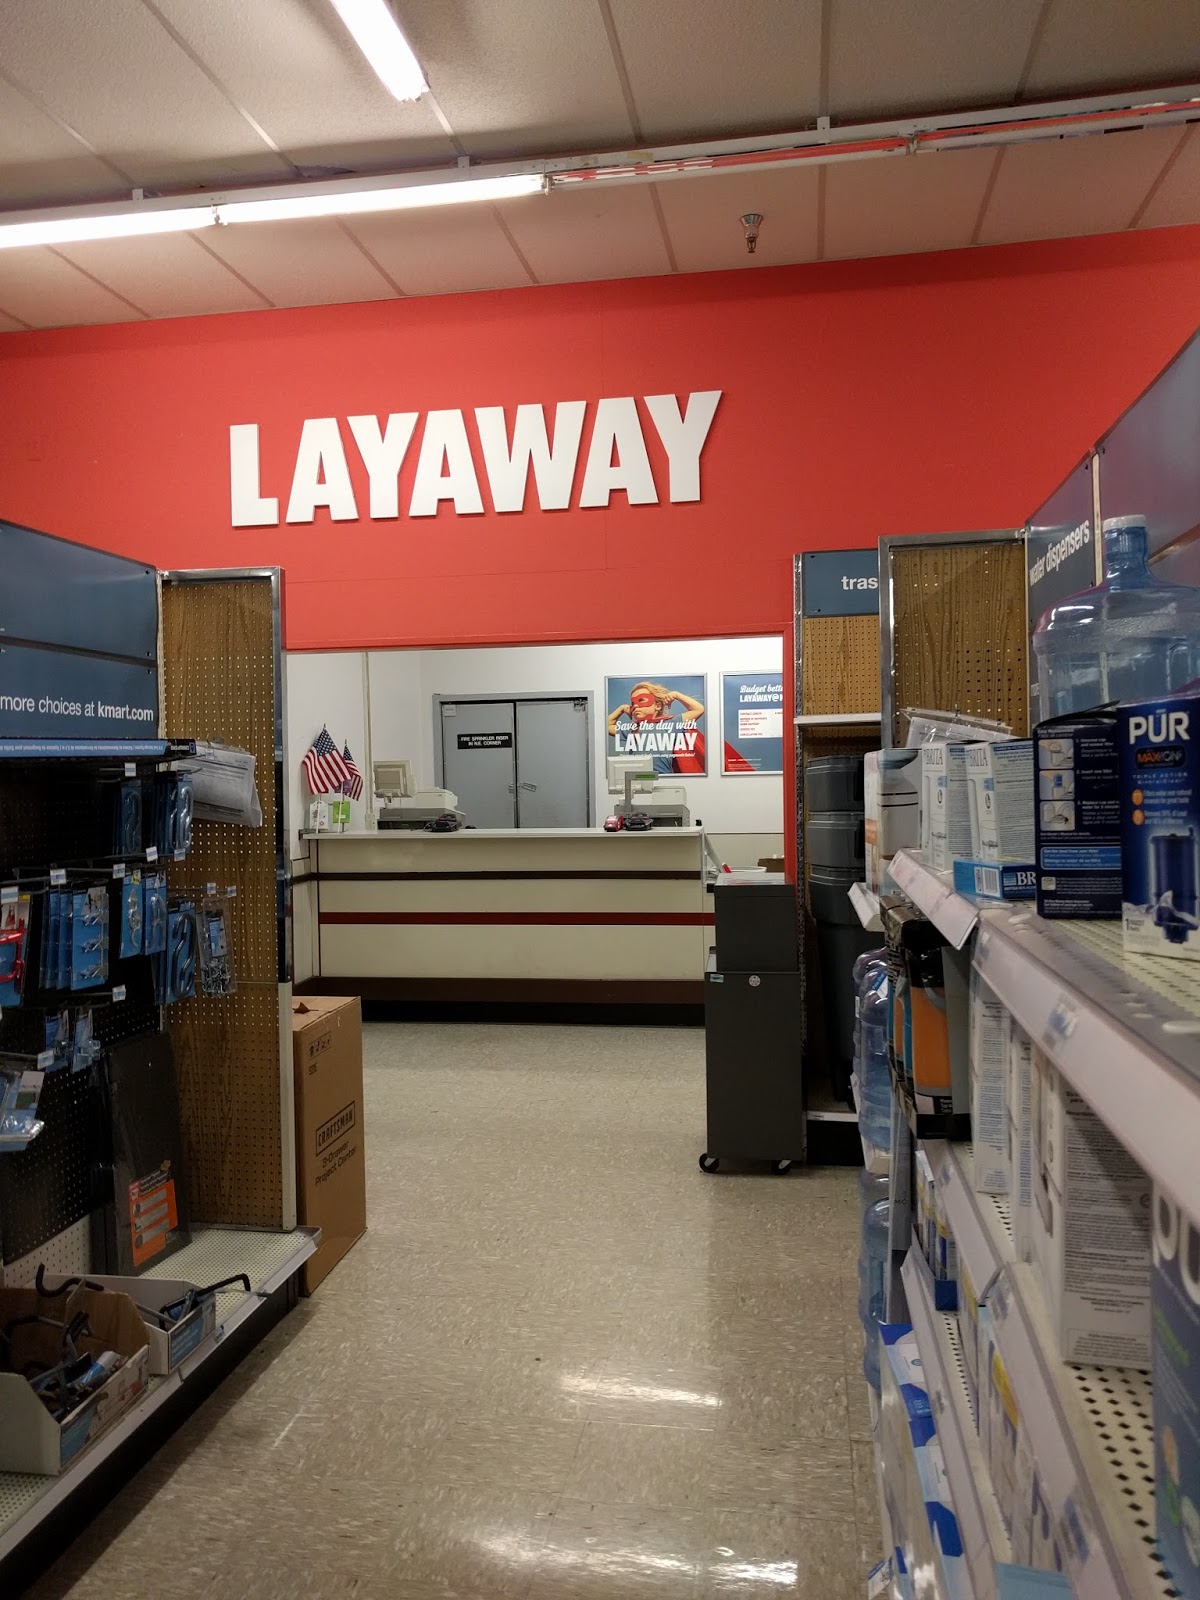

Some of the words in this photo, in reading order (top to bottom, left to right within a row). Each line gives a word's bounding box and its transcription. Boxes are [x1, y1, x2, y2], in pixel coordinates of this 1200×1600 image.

[229, 389, 723, 527] LAYAWAY
[1046, 519, 1090, 572] dispensers
[740, 685, 766, 695] Budget
[0, 695, 35, 712] more
[38, 696, 82, 716] choices
[84, 701, 95, 717] at
[98, 701, 154, 721] kmart.com
[614, 720, 638, 731] Save
[640, 719, 655, 731] the
[656, 720, 675, 733] day
[676, 718, 698, 730] with
[615, 732, 698, 752] LAYAWAY
[318, 1108, 353, 1147] CRAFTSMAN
[315, 1162, 337, 1188] Project
[337, 1146, 357, 1167] Center
